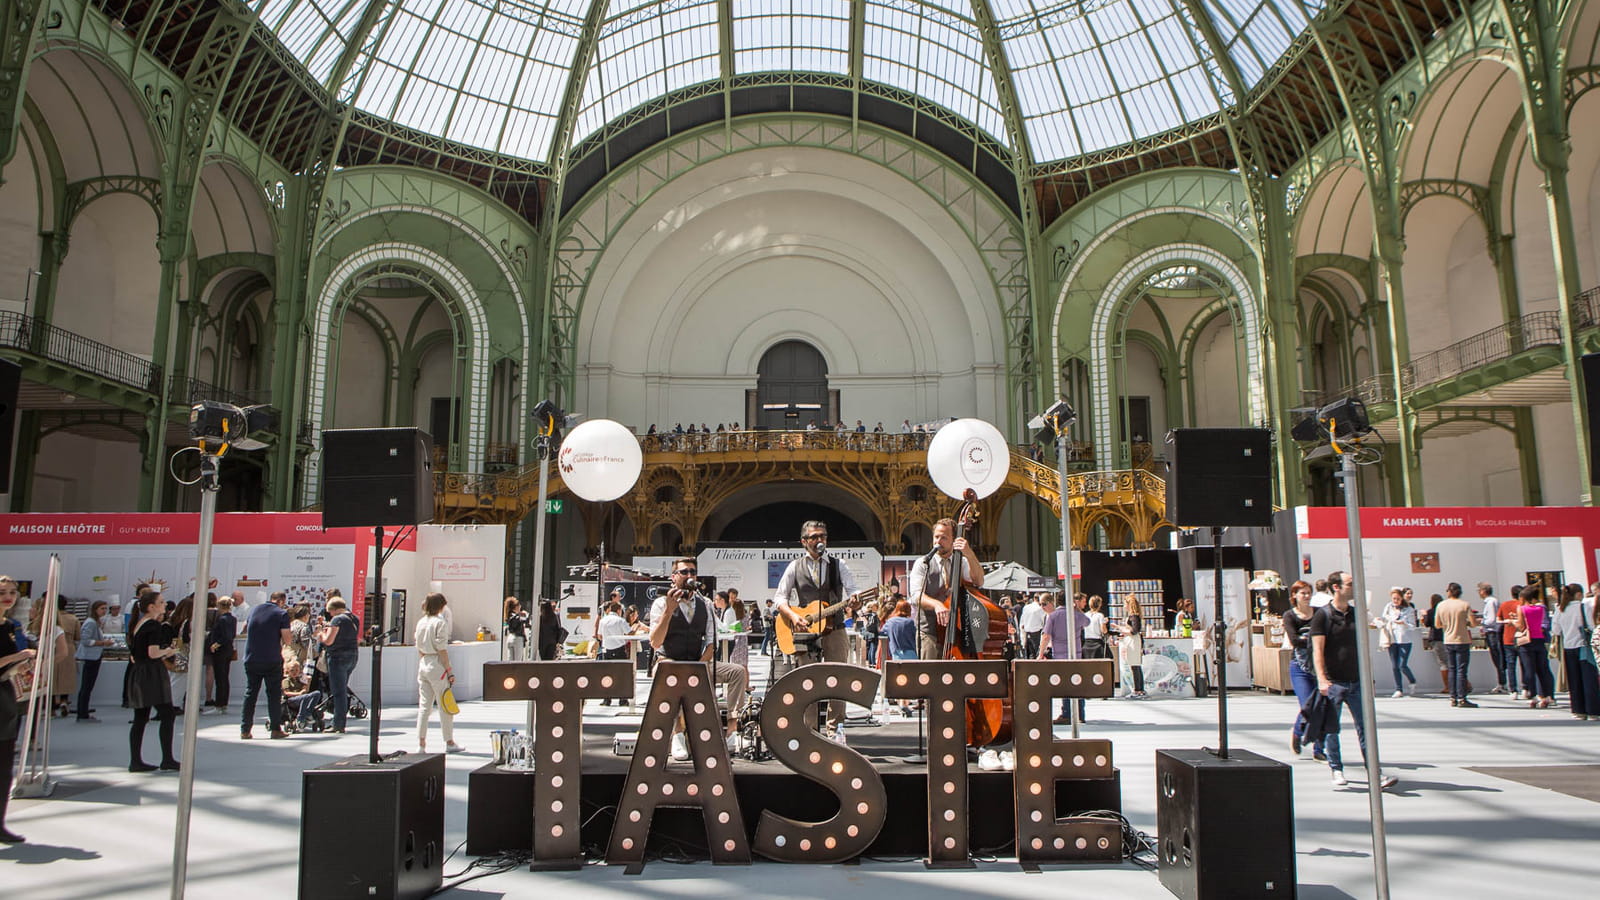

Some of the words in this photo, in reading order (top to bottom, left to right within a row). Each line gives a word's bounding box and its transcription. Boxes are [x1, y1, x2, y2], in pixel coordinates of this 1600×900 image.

[1383, 518, 1432, 527] KARAMEL
[1434, 518, 1464, 527] PARIS
[9, 524, 53, 534] MAISON
[56, 523, 106, 534] LENÔTRE
[119, 526, 134, 534] GUY
[136, 526, 171, 534] KRENZER
[715, 549, 757, 560] Théâtre
[825, 549, 865, 560] errier
[483, 660, 1123, 866] TASTE
